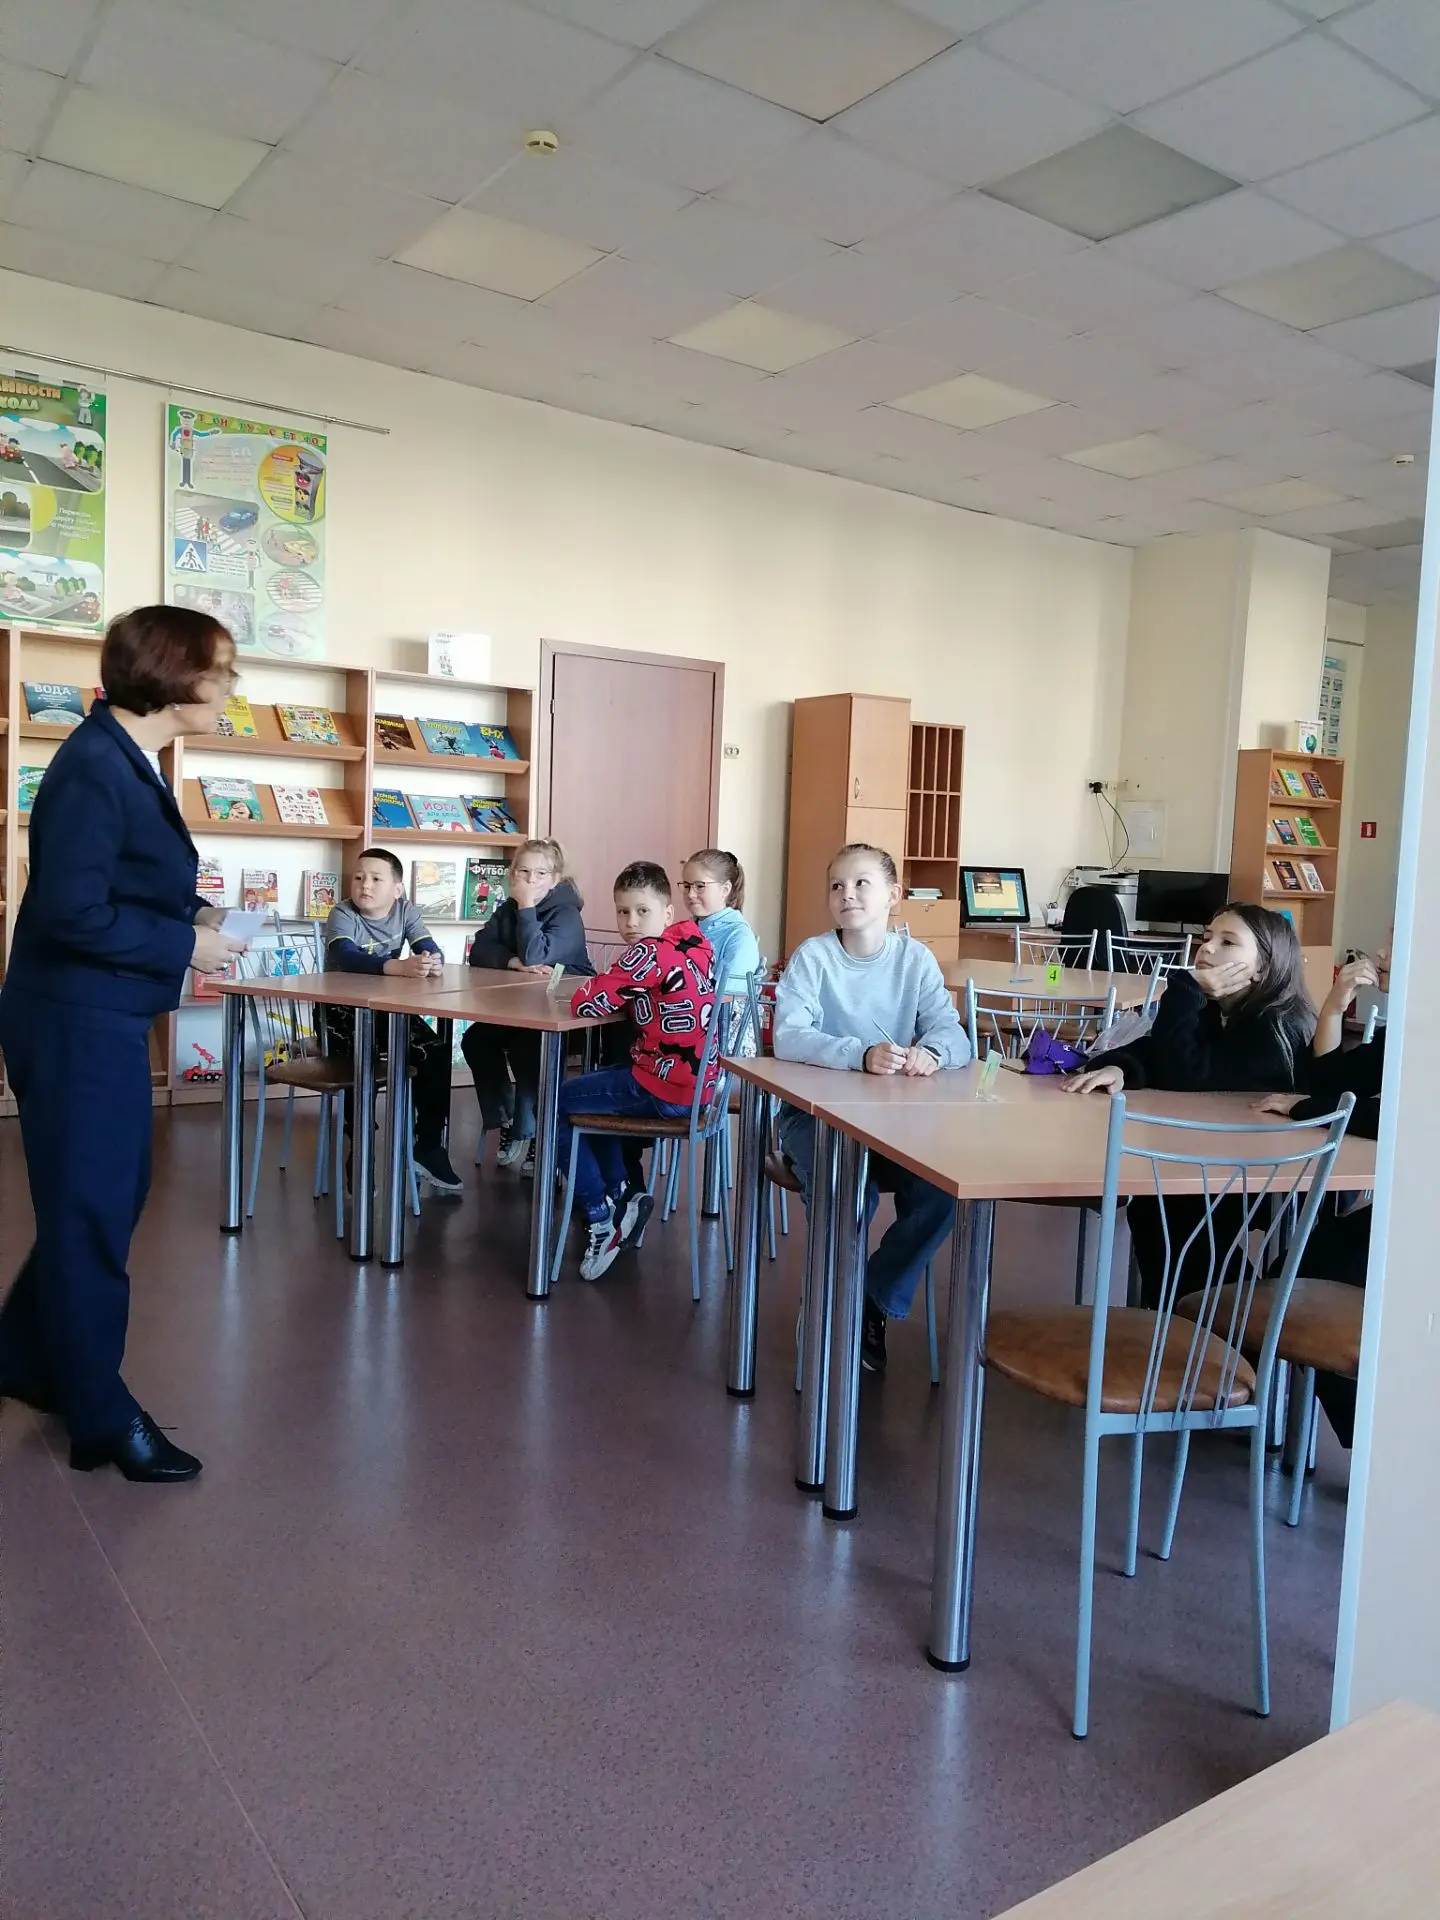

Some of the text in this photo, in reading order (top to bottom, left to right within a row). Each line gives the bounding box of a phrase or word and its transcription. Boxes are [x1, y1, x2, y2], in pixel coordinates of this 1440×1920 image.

[0, 380, 61, 399] ННОСТИ
[34, 684, 72, 696] ВОДА
[1049, 970, 1057, 981] 4
[658, 998, 697, 1034] 10
